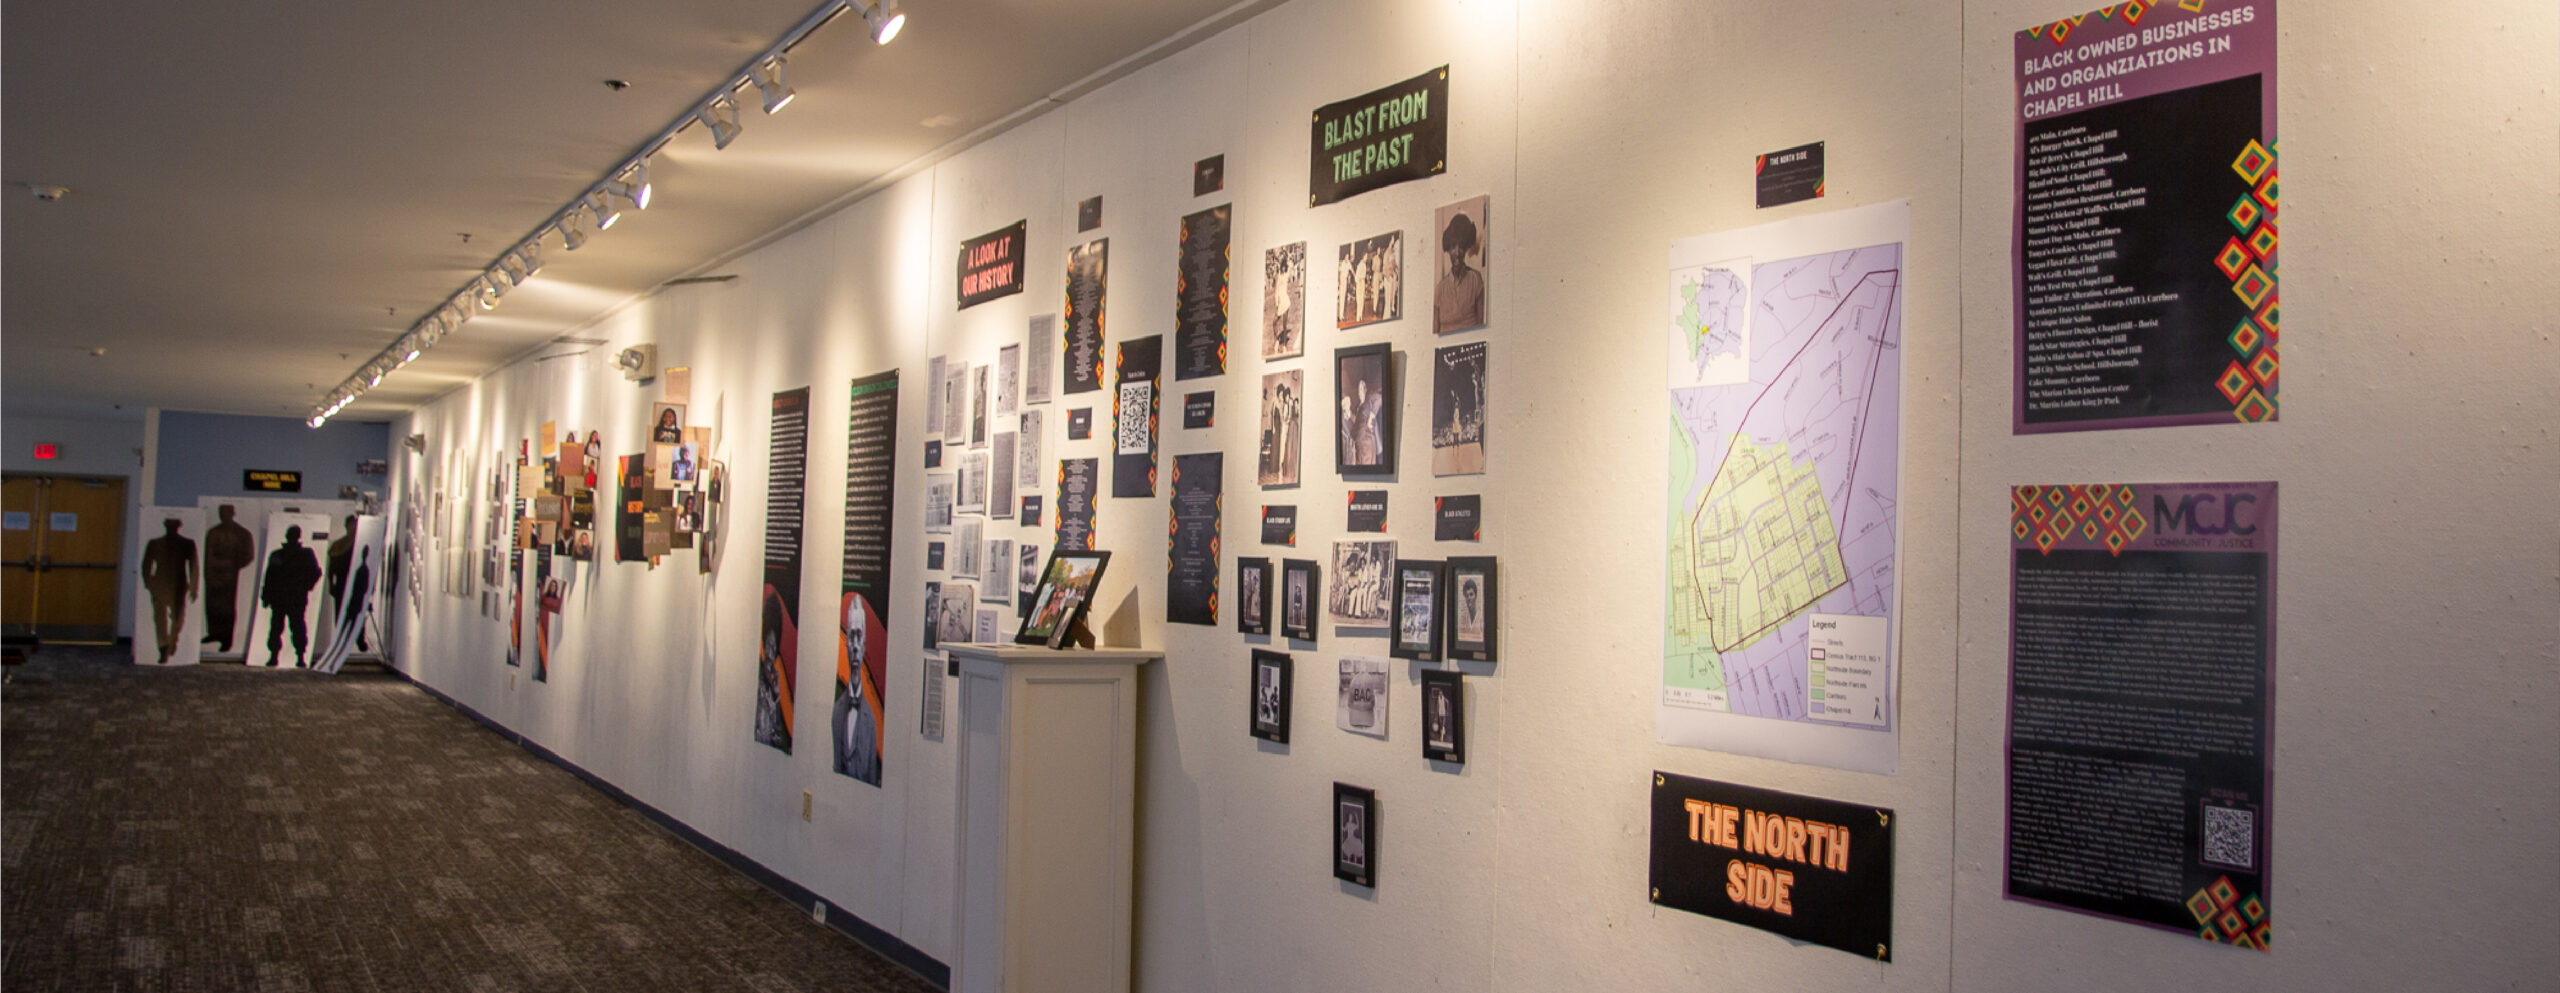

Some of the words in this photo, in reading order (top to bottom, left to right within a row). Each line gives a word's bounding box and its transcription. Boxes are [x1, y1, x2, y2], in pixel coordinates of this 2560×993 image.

[2024, 48, 2074, 76] BLACK
[2077, 33, 2136, 61] OWNED
[2142, 5, 2255, 46] BUSINESSES
[2024, 75, 2057, 97] AND
[2060, 40, 2203, 91] ORGANZIATIONS
[2208, 35, 2231, 55] IN
[2023, 90, 2084, 118] CHAPEL
[2088, 83, 2123, 105] HILL
[1324, 106, 1376, 151] BLAST
[1378, 89, 1428, 133] FROM
[2057, 126, 2086, 137] Carrboro
[2083, 132, 2104, 143] Chapel
[2104, 129, 2118, 139] Hill
[1332, 148, 1363, 184] THE
[1365, 133, 1414, 175] PAST
[1770, 157, 1779, 167] THE
[1780, 153, 1795, 164] NORTH
[1796, 150, 1808, 161] SIDE
[2029, 158, 2041, 166] Ben
[2070, 146, 2092, 158] Chapel
[2092, 143, 2104, 154] Hill
[2087, 152, 2128, 167] Hillsborough
[2069, 170, 2092, 181] Chapel
[2076, 180, 2099, 192] Chapel
[2099, 178, 2112, 189] Hill
[2028, 202, 2052, 212] Country
[2052, 197, 2079, 209] Junction
[2115, 187, 2146, 197] Carrboro
[2050, 209, 2076, 219] Chicken
[2109, 199, 2132, 210] Chapel
[2131, 197, 2145, 207] Hill
[2064, 218, 2087, 229] Chapel
[2087, 216, 2100, 226] Hill
[2090, 227, 2121, 237] Carrboro
[2077, 240, 2100, 251] Chapel
[2099, 238, 2113, 248] Hill
[967, 248, 974, 270] A
[975, 240, 997, 268] LOOK
[997, 235, 1011, 260] AT
[2079, 251, 2102, 263] Chapel
[2063, 266, 2086, 277] Chapel
[2085, 264, 2098, 274] Hill
[962, 273, 978, 297] OUR
[978, 261, 1014, 292] HISTORY
[2078, 276, 2101, 287] Chapel
[2100, 274, 2114, 284] Hill
[2103, 285, 2134, 295] Carrboro
[2146, 292, 2179, 303] Carrboro
[2097, 322, 2120, 333] Chapel
[2120, 321, 2133, 330] Hill
[2091, 335, 2114, 346] Chapel
[2114, 333, 2127, 343] Hill
[2106, 346, 2128, 356] Chapel
[2128, 345, 2142, 354] Hill
[2097, 357, 2139, 368] Hillsborough
[2070, 374, 2100, 383] Carrboro
[2029, 390, 2040, 398] The
[2083, 385, 2108, 395] Jackson
[2107, 384, 2129, 392] Center
[2039, 401, 2060, 409] Martin
[2060, 399, 2081, 408] Luther
[2081, 398, 2097, 406] King
[2103, 395, 2120, 405] Park
[2153, 493, 2257, 535] MCJC
[2154, 538, 2212, 548] COMMUNITY
[2219, 539, 2255, 549] JUSTICE
[1812, 620, 1837, 630] Legend
[1353, 688, 1372, 702] BAC
[1684, 798, 1739, 849] THE
[1744, 809, 1849, 872] NORTH
[1726, 859, 1794, 916] SIDE
